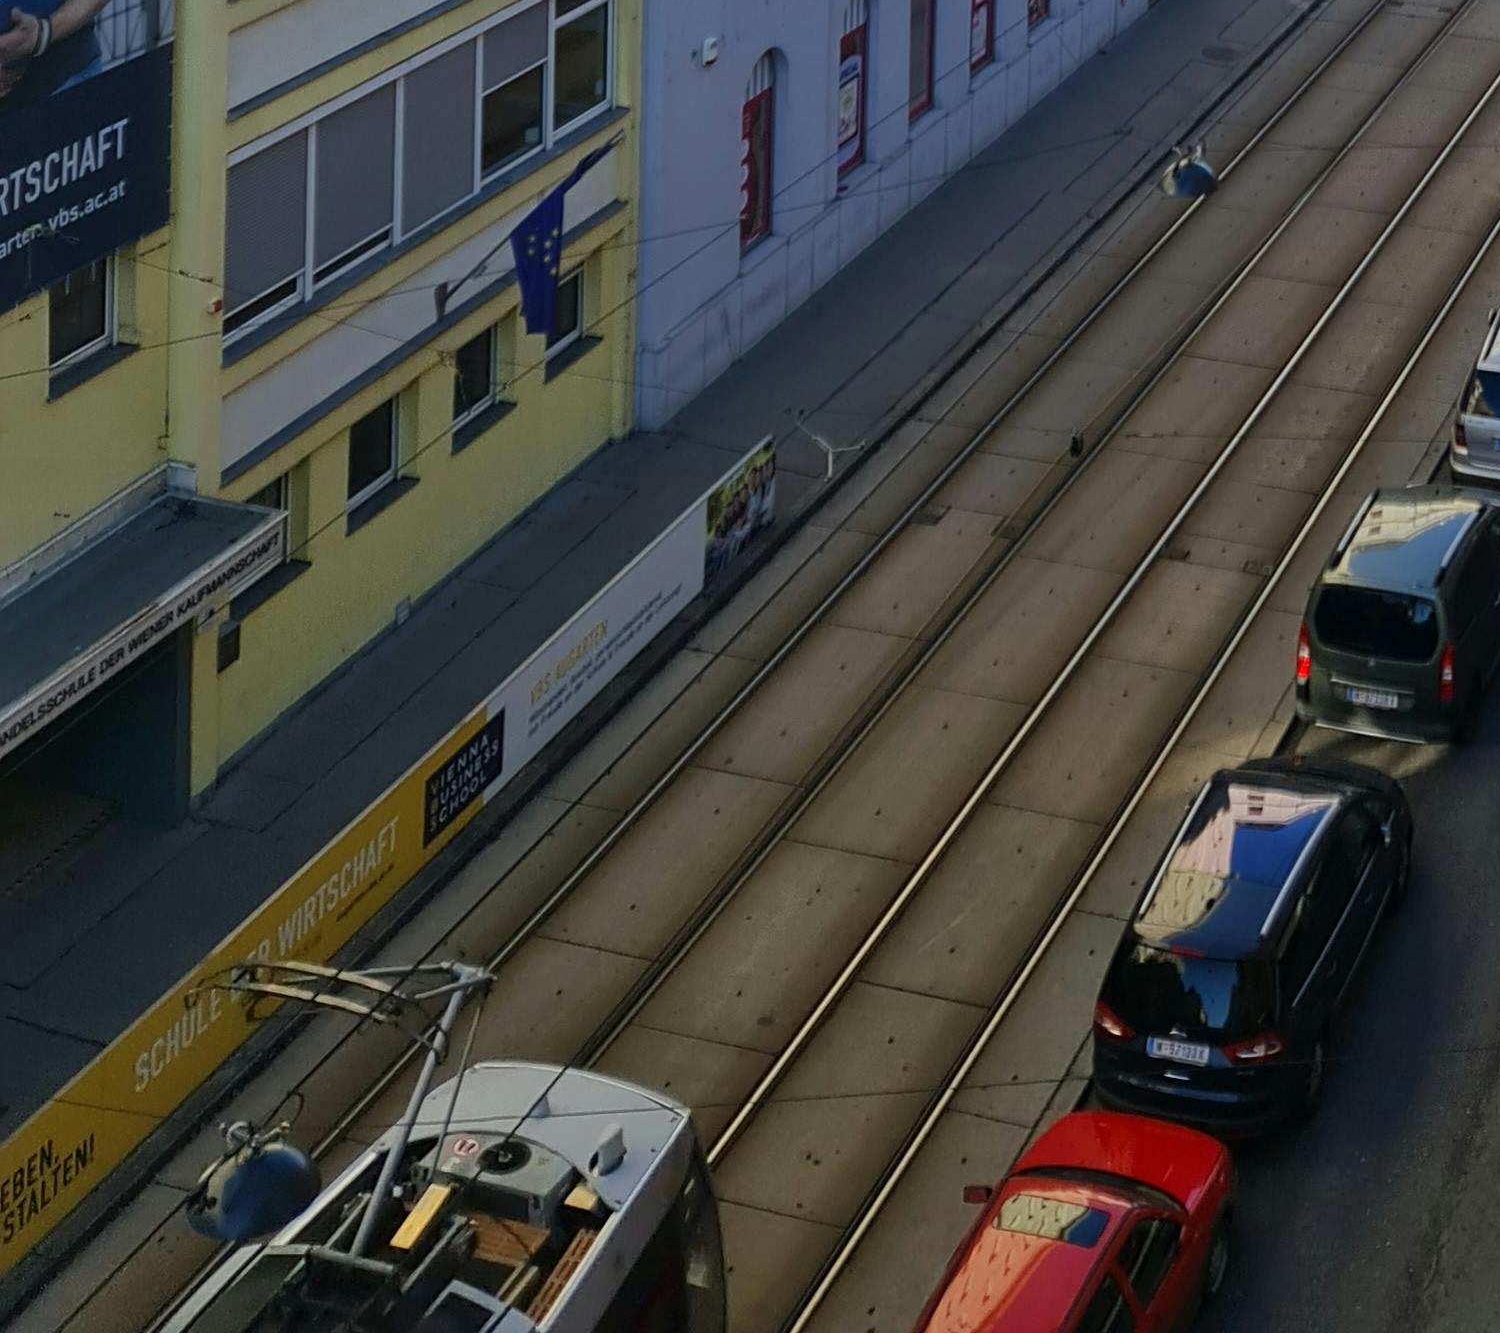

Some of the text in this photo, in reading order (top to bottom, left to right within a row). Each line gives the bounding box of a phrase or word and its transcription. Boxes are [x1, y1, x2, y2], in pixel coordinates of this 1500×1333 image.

[0, 118, 129, 216] RTSCHAFT
[0, 181, 126, 259] artenvbs.ac.at
[99, 647, 125, 675] DER
[127, 609, 174, 654] WIENER
[176, 532, 281, 618] KAUFMANNSCHAFT
[430, 772, 488, 833] SCHOOL
[431, 733, 489, 794] VIENNA
[133, 989, 223, 1093] SCHULE
[277, 816, 399, 956] WIRTSCHAFT
[3, 1133, 95, 1244] STALTEN!
